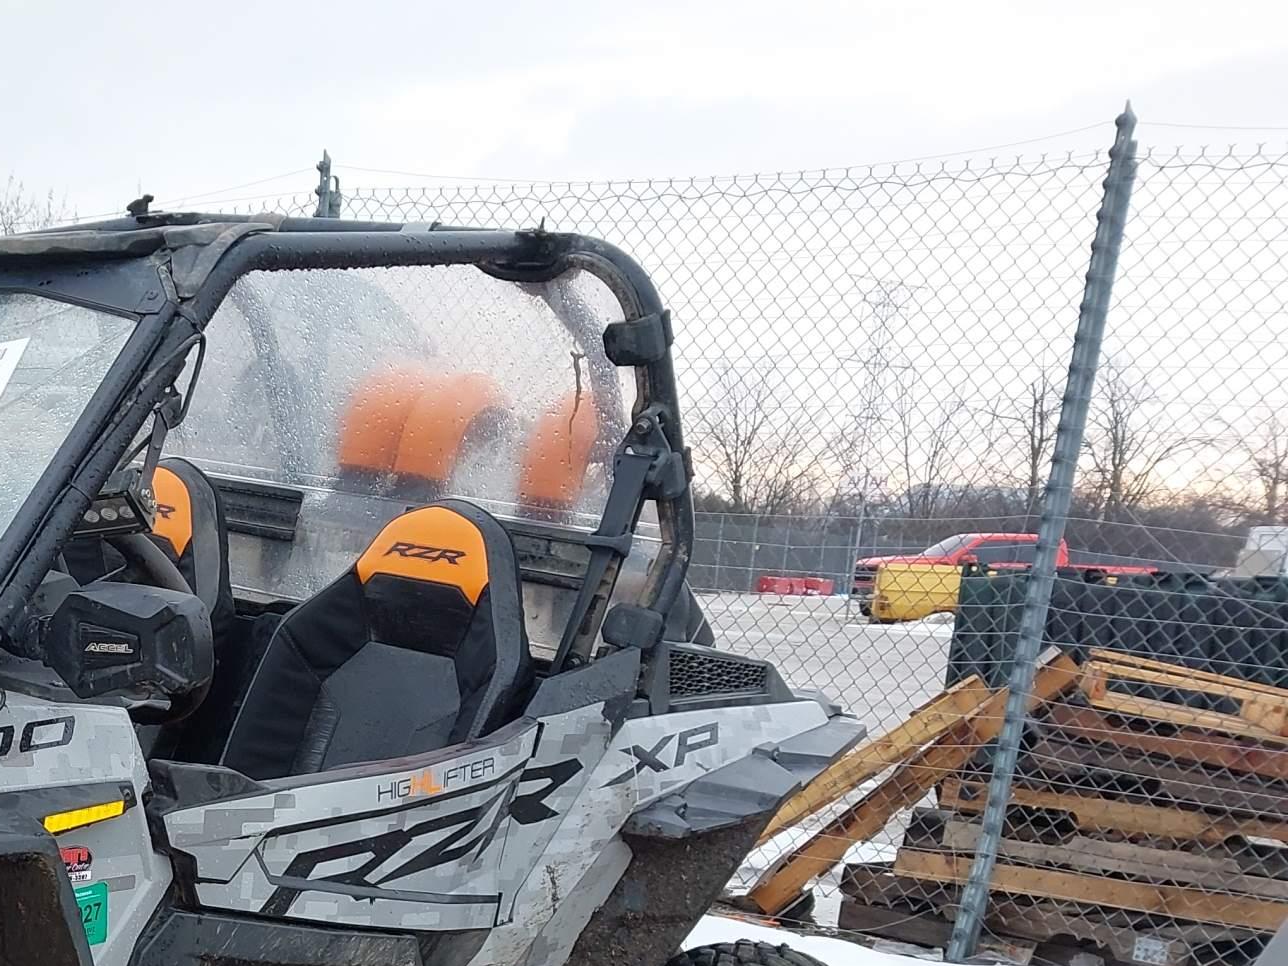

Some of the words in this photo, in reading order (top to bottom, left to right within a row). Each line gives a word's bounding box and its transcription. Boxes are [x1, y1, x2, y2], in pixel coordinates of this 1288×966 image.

[383, 542, 467, 566] RZR
[598, 721, 719, 790] XP
[79, 902, 101, 923] 27
